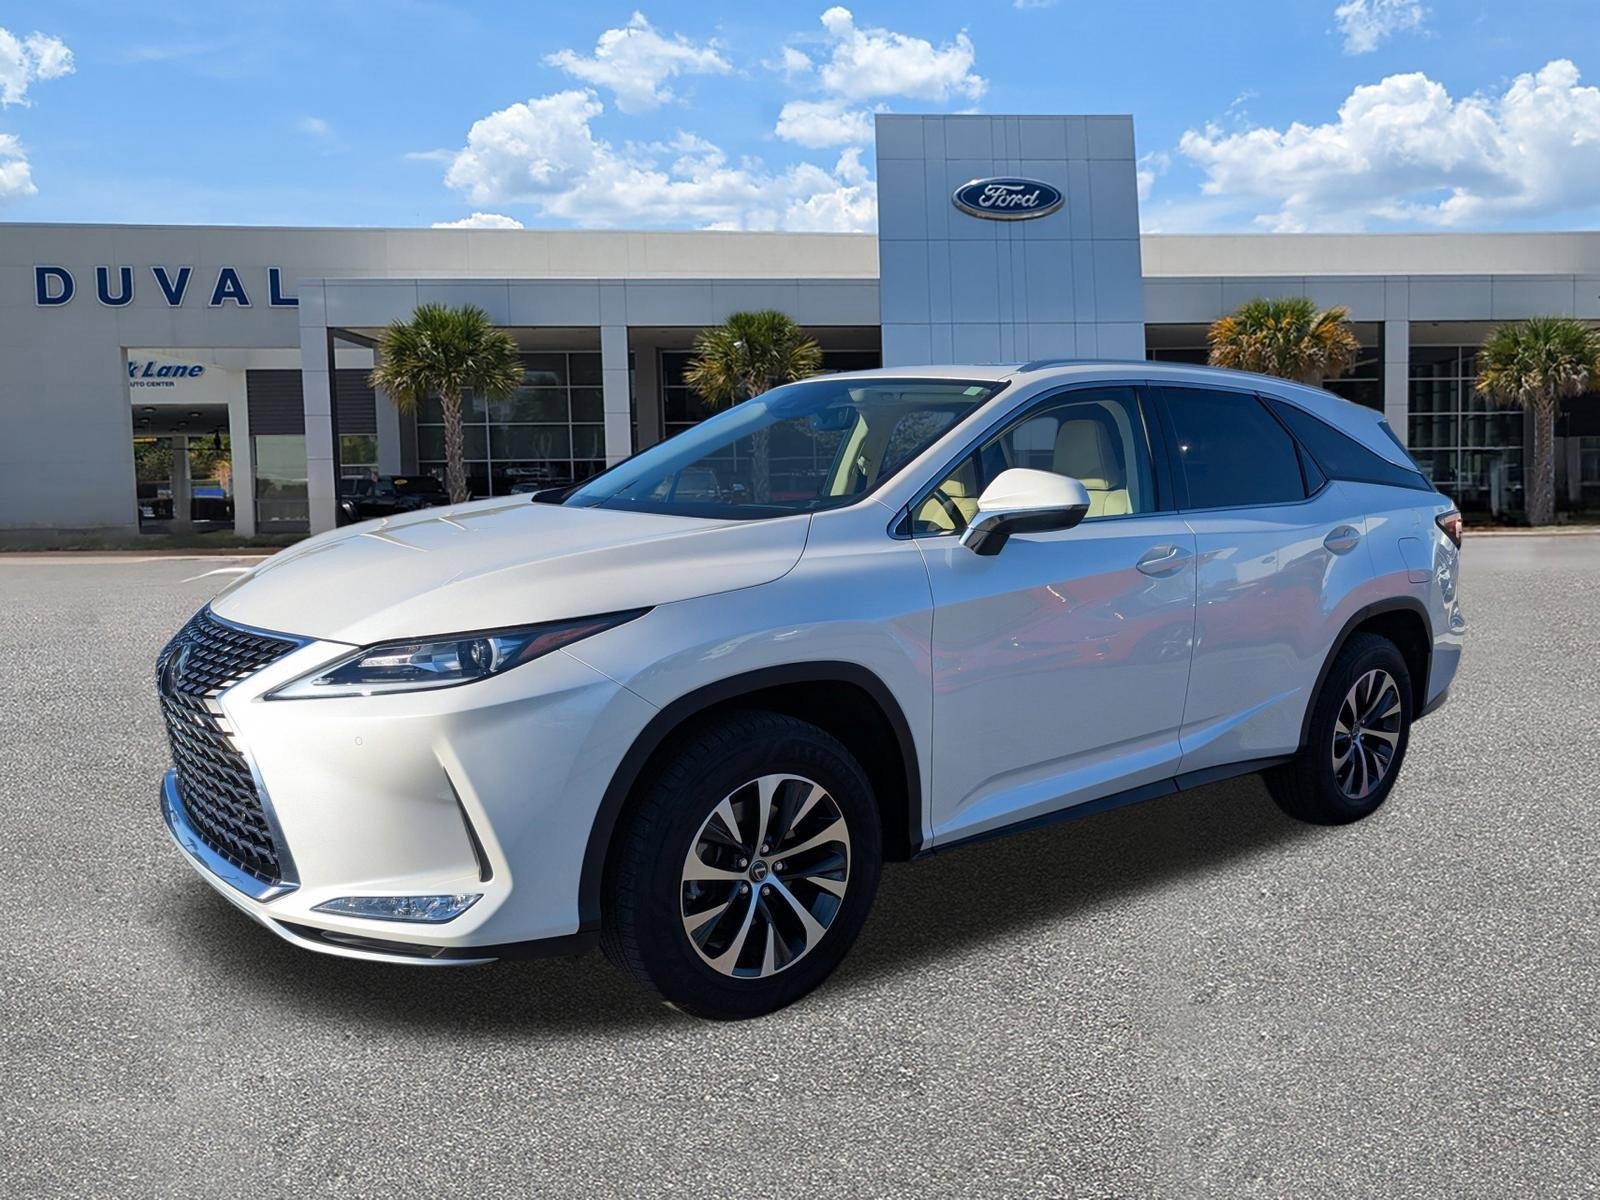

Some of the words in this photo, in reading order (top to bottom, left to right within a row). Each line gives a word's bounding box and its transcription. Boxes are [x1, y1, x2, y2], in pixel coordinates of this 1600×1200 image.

[978, 184, 1040, 207] Ford
[33, 265, 299, 308] DUVAL
[141, 361, 204, 378] Lane
